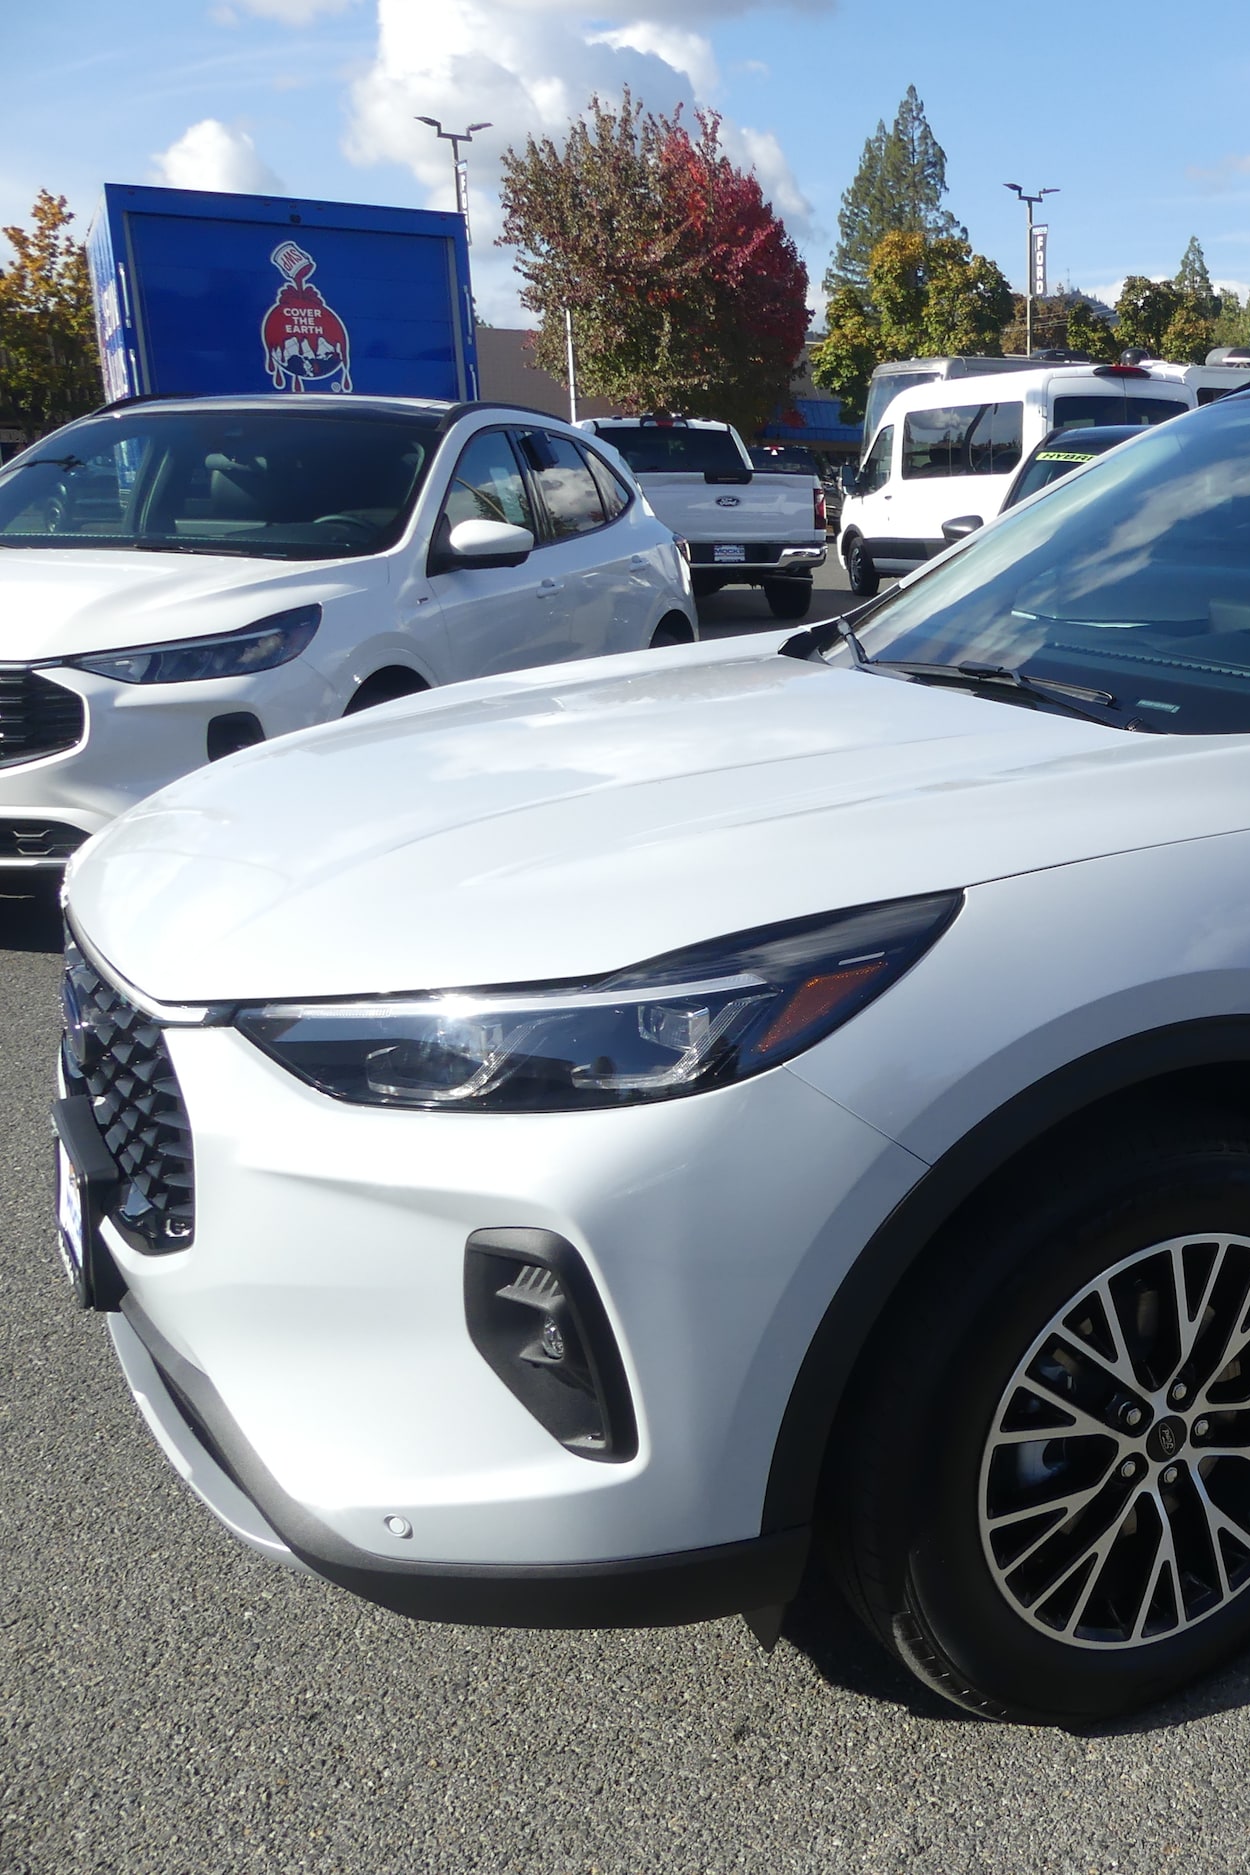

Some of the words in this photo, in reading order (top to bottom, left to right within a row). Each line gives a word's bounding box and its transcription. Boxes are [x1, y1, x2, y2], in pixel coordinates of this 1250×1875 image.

[281, 249, 303, 271] SWP
[1036, 235, 1044, 294] FORD
[283, 307, 322, 318] COVER
[292, 317, 315, 326] THE
[285, 324, 323, 335] EARTH
[1042, 453, 1093, 461] HYBRI
